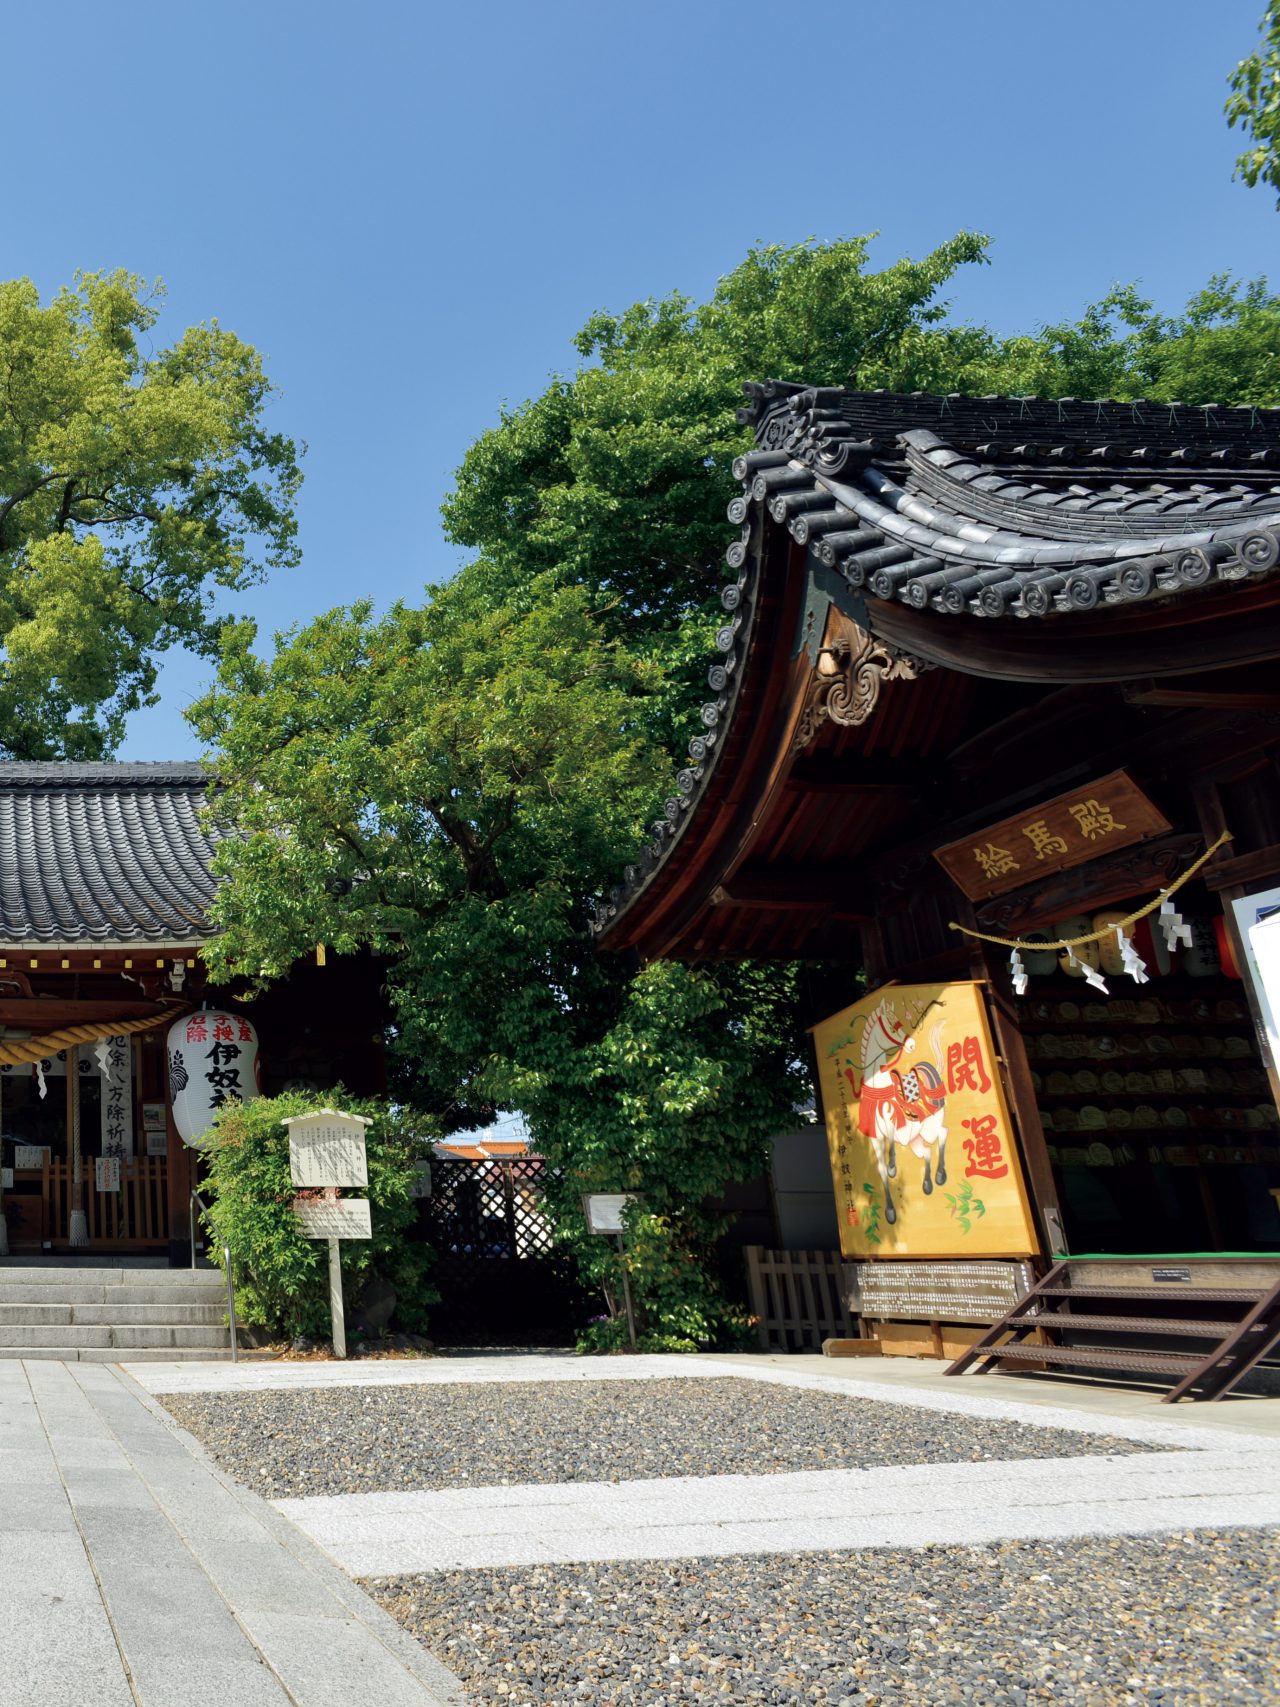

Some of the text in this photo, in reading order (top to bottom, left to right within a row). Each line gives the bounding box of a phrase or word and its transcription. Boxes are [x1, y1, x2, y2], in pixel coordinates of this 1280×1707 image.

[974, 799, 1127, 879] 絵馬殿
[186, 1015, 208, 1043] 厄除
[212, 1015, 234, 1041] 子授
[233, 1016, 254, 1042] 安産
[947, 1036, 1008, 1180] 開運
